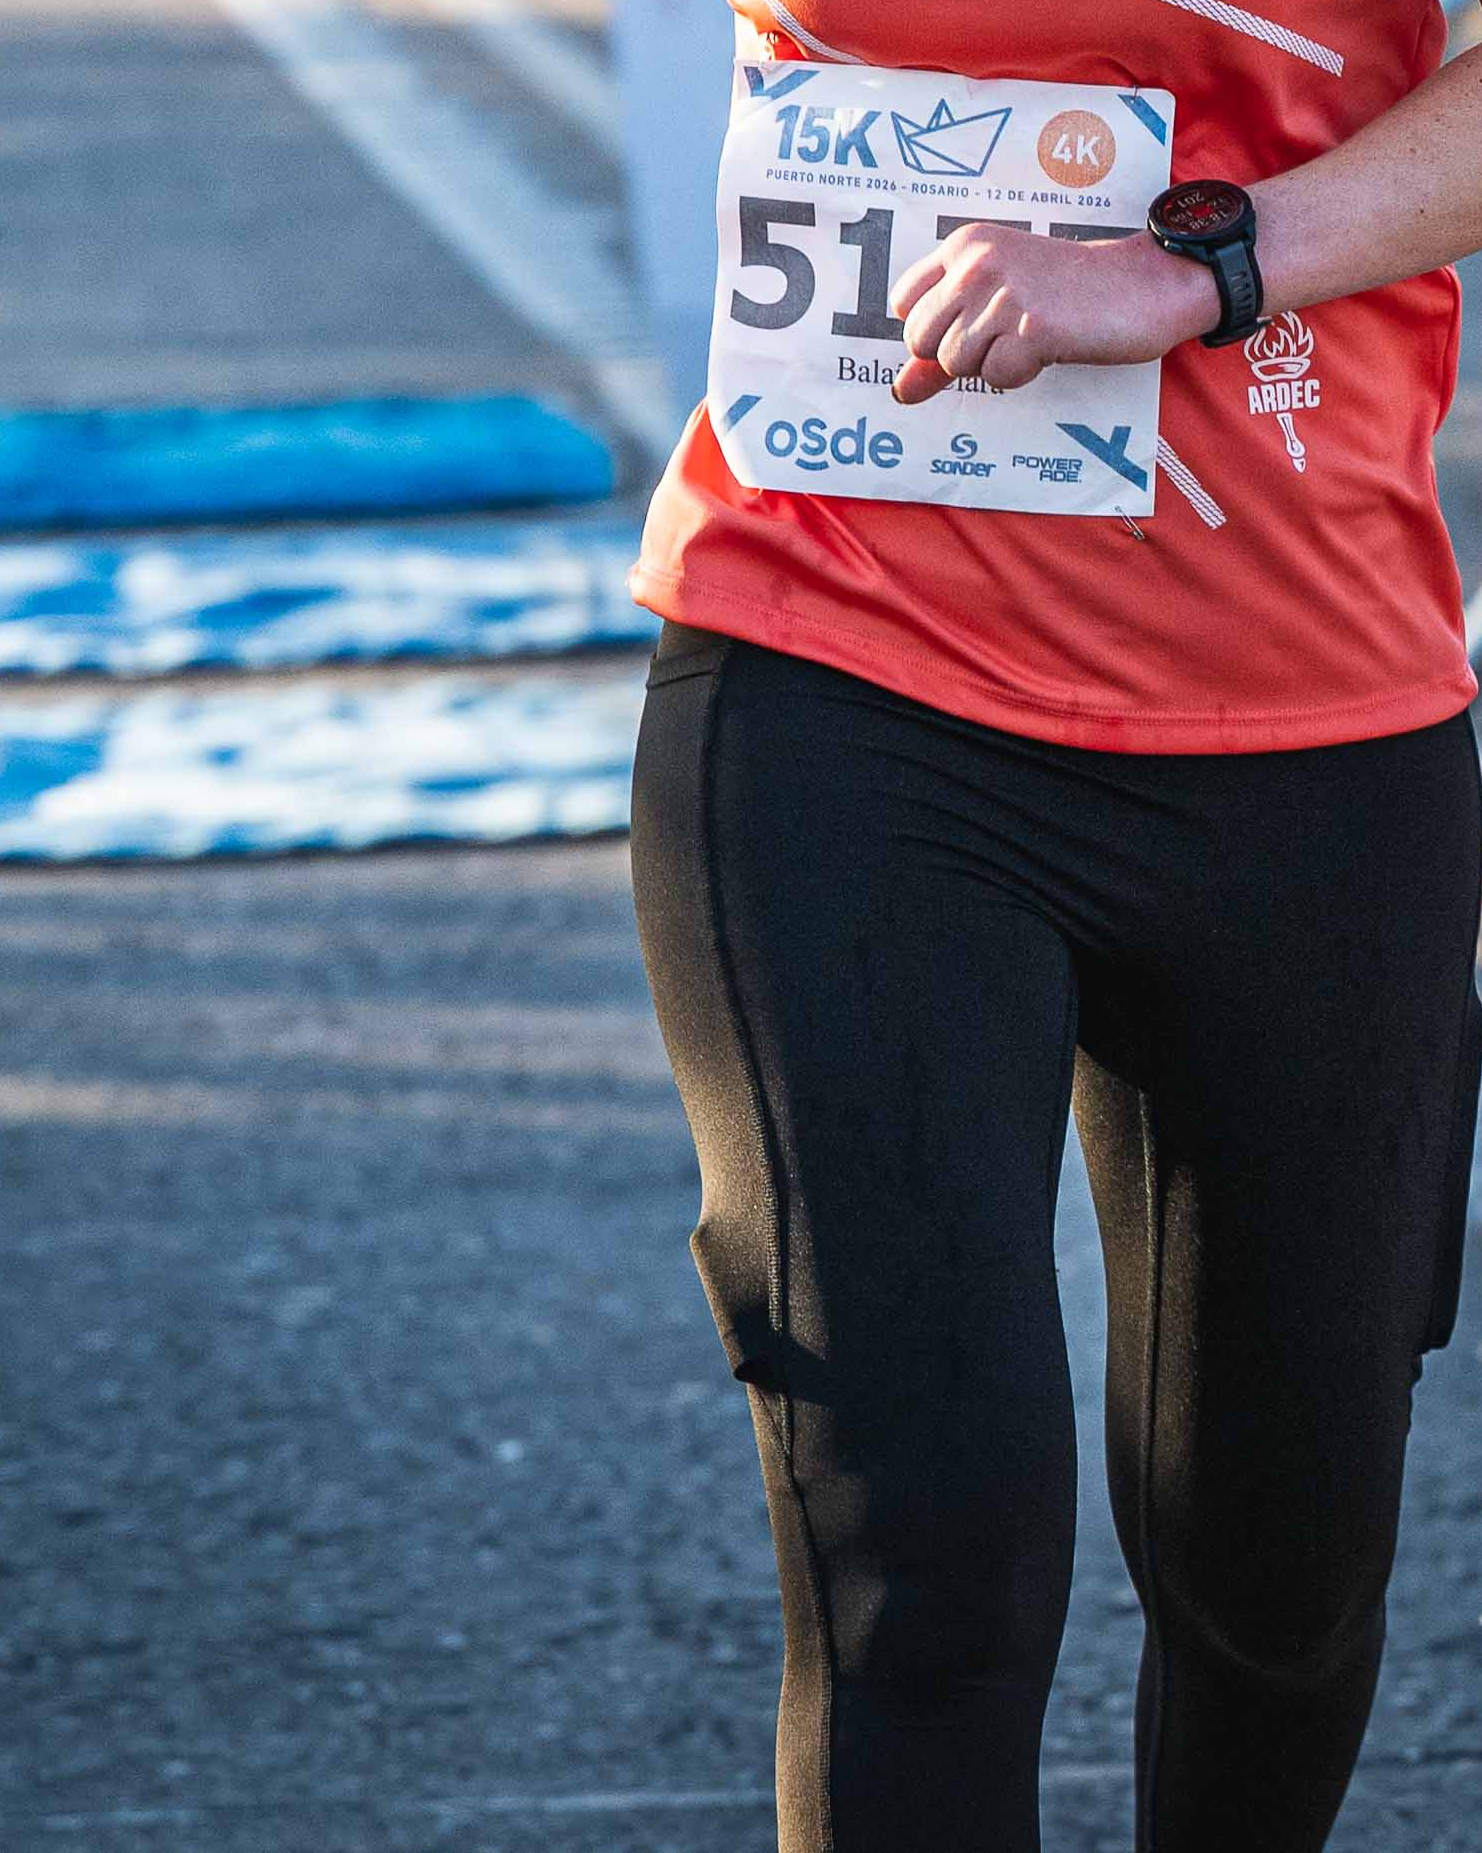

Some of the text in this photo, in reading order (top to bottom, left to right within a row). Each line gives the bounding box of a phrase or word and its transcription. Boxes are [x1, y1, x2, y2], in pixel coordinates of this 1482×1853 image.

[775, 104, 882, 168] 15K
[1051, 132, 1102, 167] 4K
[766, 168, 814, 183] PUERTO
[819, 173, 861, 188] NORTE
[867, 178, 897, 192] 2026
[911, 183, 969, 198] ROSARIO
[987, 189, 1001, 200] 12
[1008, 190, 1025, 201] DE
[1031, 192, 1072, 205] ABRIL
[1078, 195, 1111, 208] 2026
[730, 196, 1148, 340] 51
[837, 356, 904, 386] Bala
[1248, 379, 1320, 414] ARDEC
[765, 416, 903, 470] osde
[1012, 454, 1083, 471] POWER
